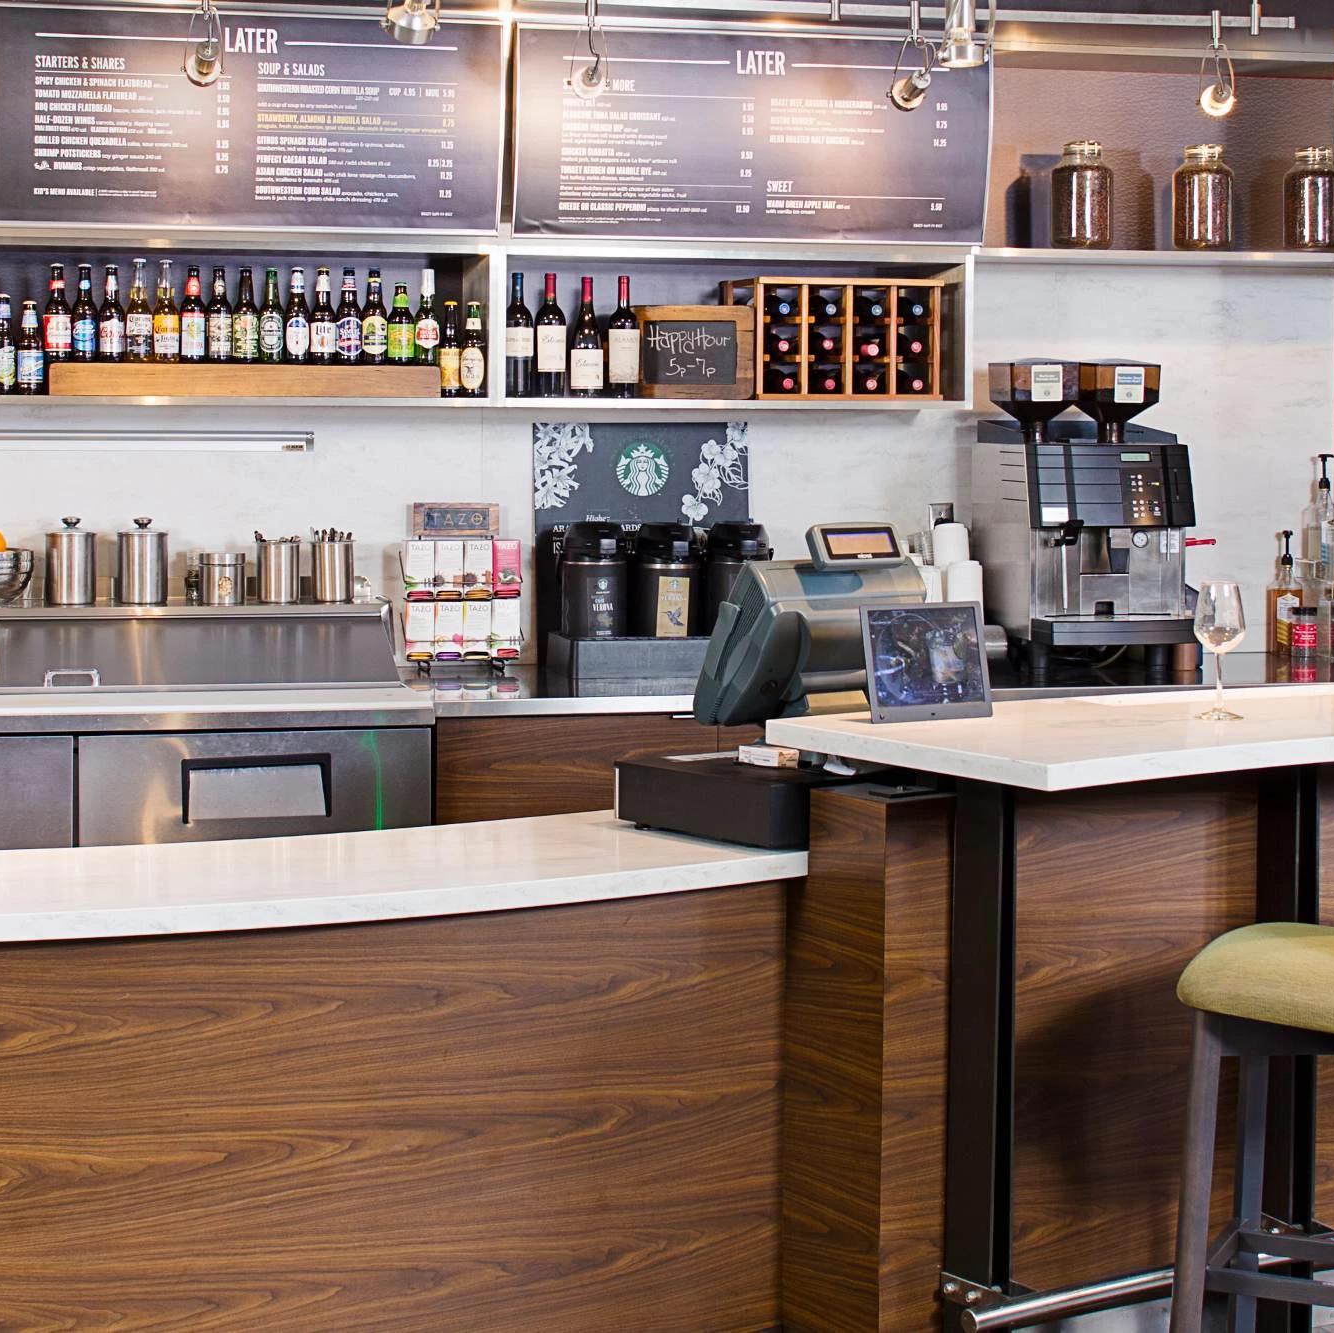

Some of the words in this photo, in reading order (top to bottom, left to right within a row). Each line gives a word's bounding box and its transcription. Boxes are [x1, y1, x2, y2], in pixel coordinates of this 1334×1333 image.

[224, 27, 278, 54] LATER
[35, 55, 79, 68] STARTERS
[82, 57, 89, 69] &
[91, 57, 125, 71] SHARES
[736, 49, 786, 77] LATER
[258, 62, 280, 75] SOUP
[284, 64, 289, 75] &
[292, 64, 325, 77] SALADS
[35, 77, 53, 85] SPICY
[55, 77, 82, 86] CHICKEN
[89, 79, 116, 87] SPINACH
[118, 79, 152, 88] FLATBREAD
[613, 80, 635, 92] MORE
[35, 89, 60, 98] TOMATO
[61, 90, 101, 99] MOZZARELLA
[103, 91, 137, 100] FLATBREAD
[389, 87, 401, 96] CUP
[35, 103, 48, 112] BBQ
[50, 103, 76, 112] CHICKEN
[78, 104, 112, 113] FLATBREAD
[35, 115, 73, 124] HALF-DOZEN
[74, 116, 95, 125] WINGS
[35, 136, 60, 145] GRILLED
[61, 136, 88, 145] CHICKEN
[89, 137, 127, 147] QUESADILLA
[257, 136, 279, 145] CITRUS
[280, 137, 306, 146] SPINACH
[307, 137, 327, 146] SALAD
[35, 149, 59, 157] SHRIMP
[60, 150, 101, 158] POTSTICKERS
[256, 155, 282, 164] PERFECT
[283, 155, 306, 165] CAESAR
[308, 156, 327, 165] SALAD
[54, 162, 82, 170] HUMMUS
[256, 167, 275, 176] ASIAN
[276, 168, 302, 177] CHICKEN
[303, 168, 323, 177] SALAD
[321, 187, 341, 196] SALAD
[767, 181, 793, 193] SWEET
[559, 203, 580, 211] CHEESE
[581, 203, 589, 211] OR
[590, 203, 614, 211] CLASSIC
[615, 203, 646, 212] PEPPERONI
[431, 513, 483, 525] TAZO
